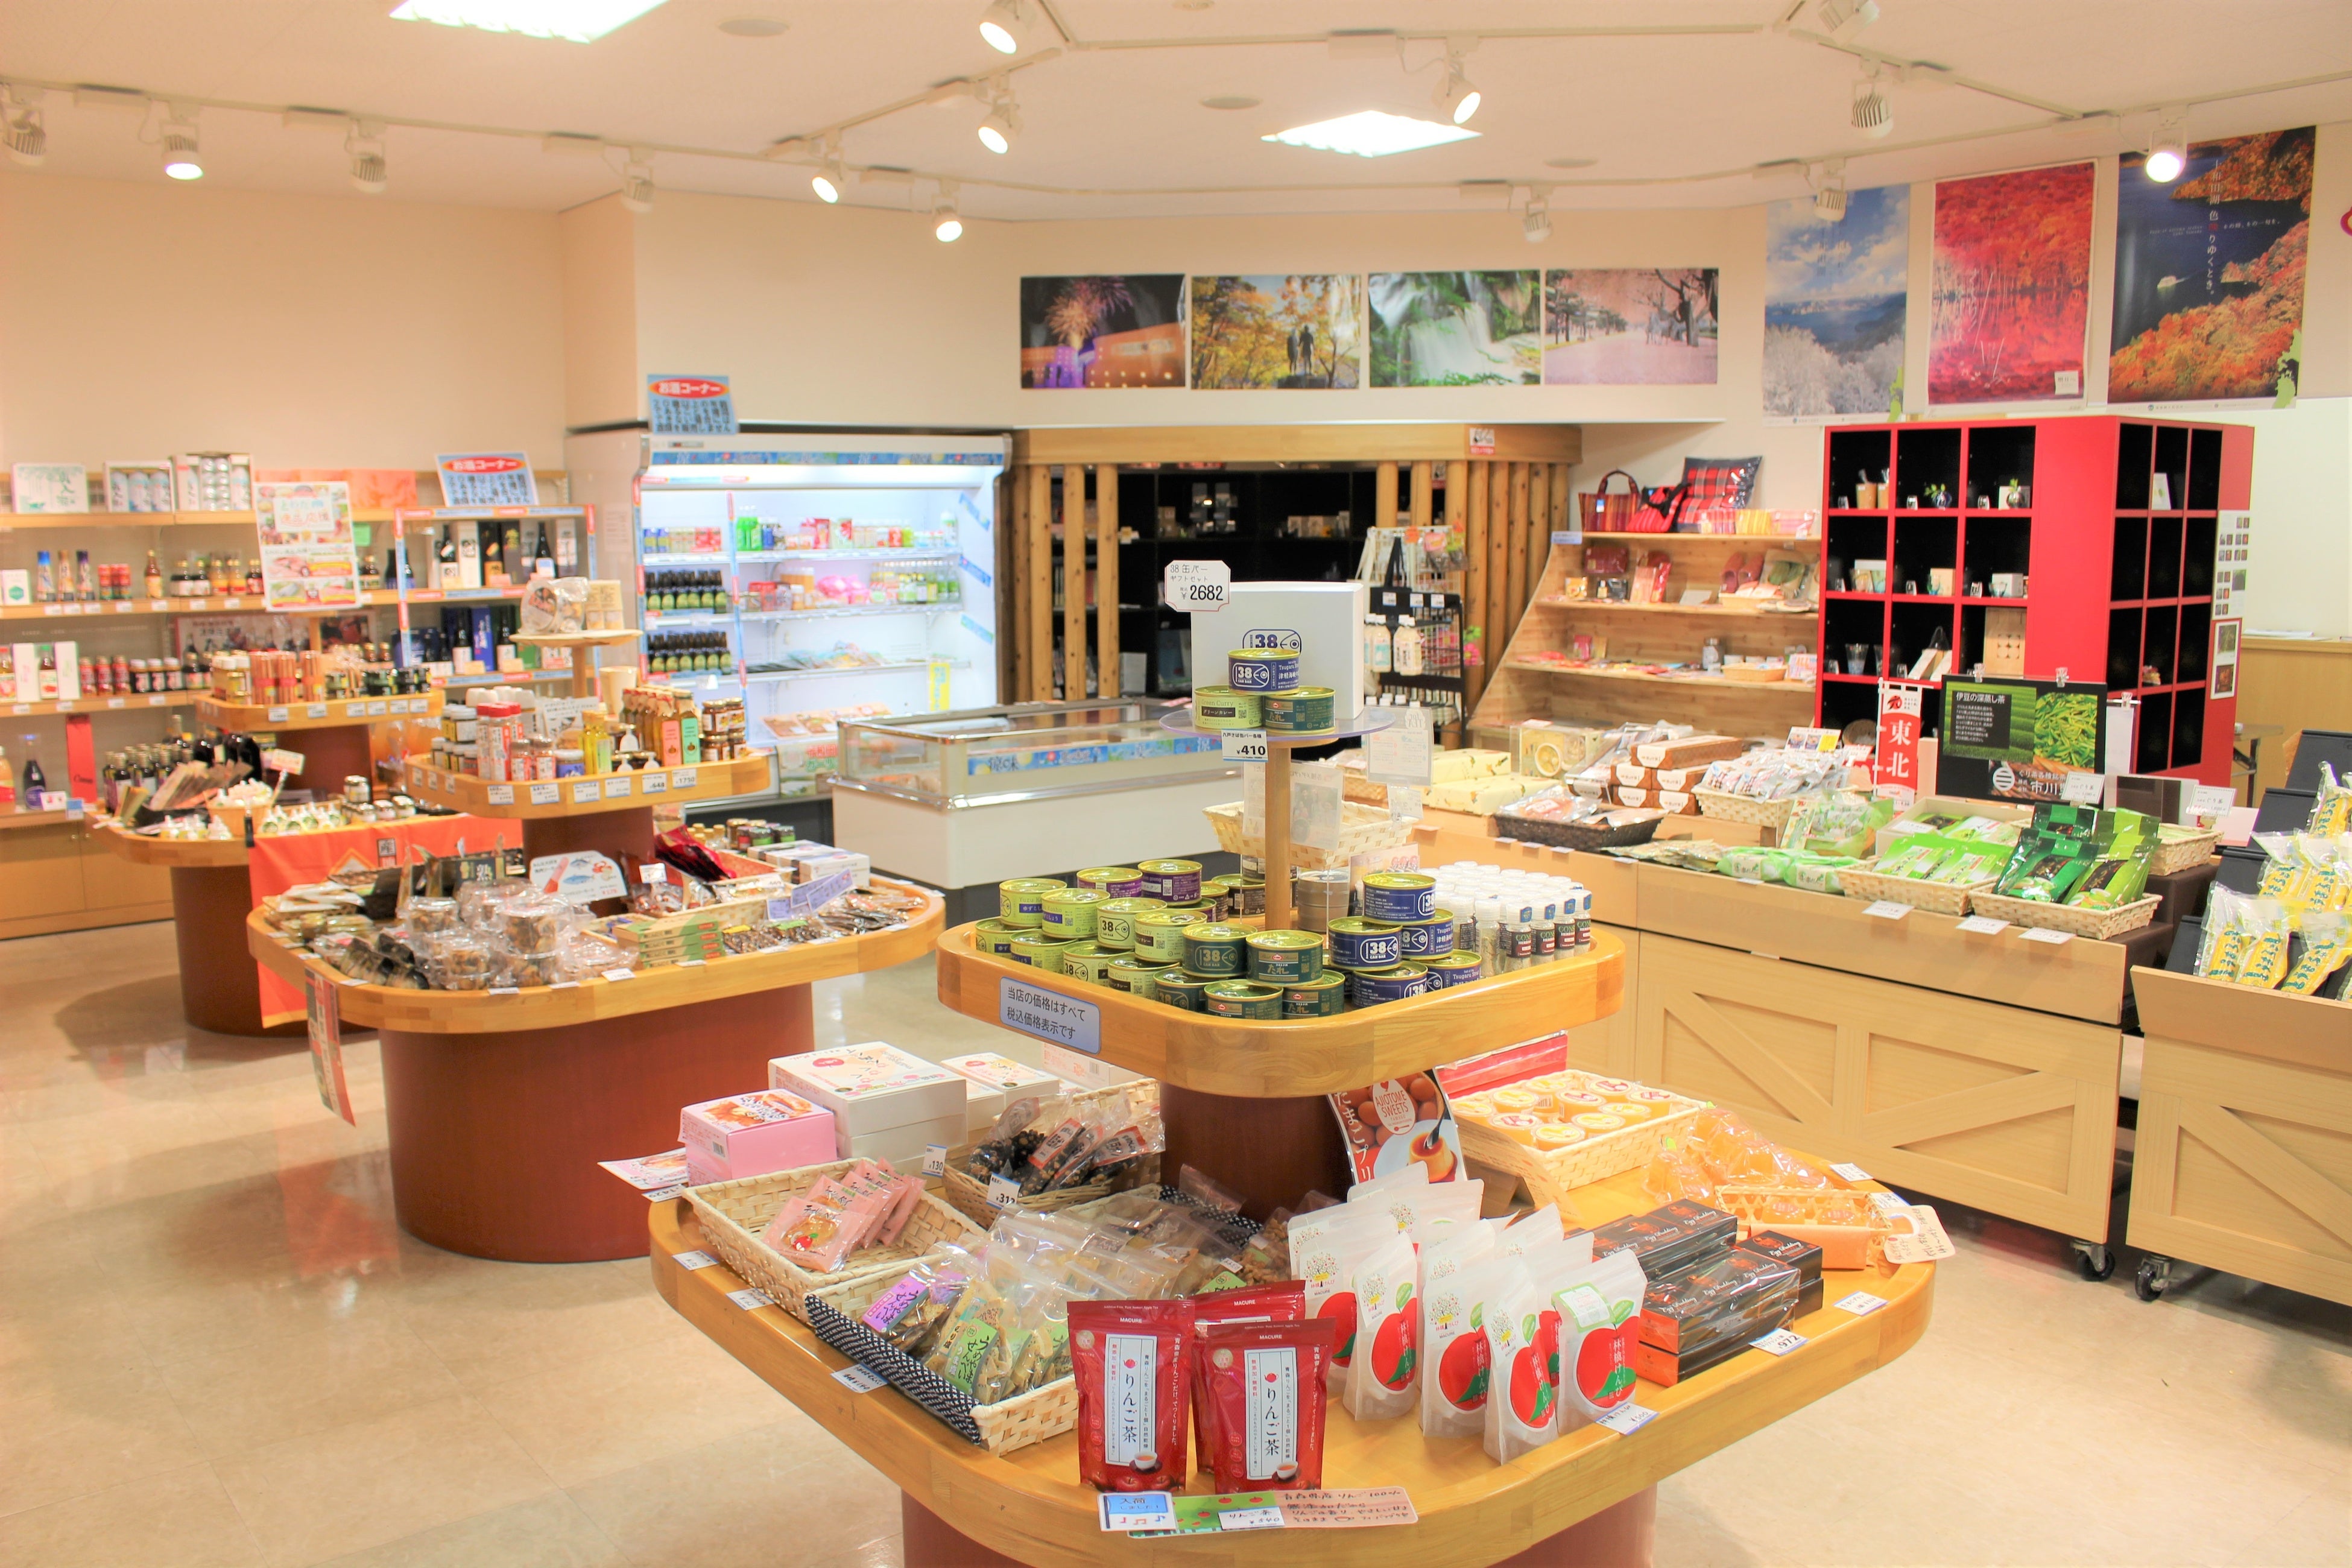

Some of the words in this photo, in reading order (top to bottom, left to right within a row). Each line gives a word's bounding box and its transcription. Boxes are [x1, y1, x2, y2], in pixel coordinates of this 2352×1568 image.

[659, 381, 721, 395] お酒コーナー
[452, 459, 518, 471] お酒コーナー
[1255, 634, 1278, 648] 38
[1238, 666, 1253, 679] 38
[1956, 692, 2006, 704] 伊豆の深蒸し茶
[1236, 745, 1266, 755] ¥410
[1886, 719, 1912, 778] 東北
[1102, 920, 1114, 932] 38
[1370, 941, 1386, 954] 38
[1203, 949, 1221, 962] 38
[1065, 963, 1074, 975] 38
[1266, 964, 1289, 975] たれ
[1412, 985, 1424, 997] 38
[1008, 986, 1086, 1021] 当店の価格はすべて
[1007, 1007, 1076, 1040] 税込価格表示です
[1375, 1090, 1408, 1107] AJIOTOME
[1381, 1101, 1409, 1118] SWEETS
[1769, 1248, 1781, 1257] Egg
[1781, 1241, 1802, 1252] Pudding
[1702, 1287, 1716, 1297] Egg
[1716, 1279, 1738, 1290] Pudding
[1122, 1374, 1137, 1443] りんご茶
[1264, 1387, 1280, 1456] りんご茶
[1229, 1510, 1273, 1519] りんご茶
